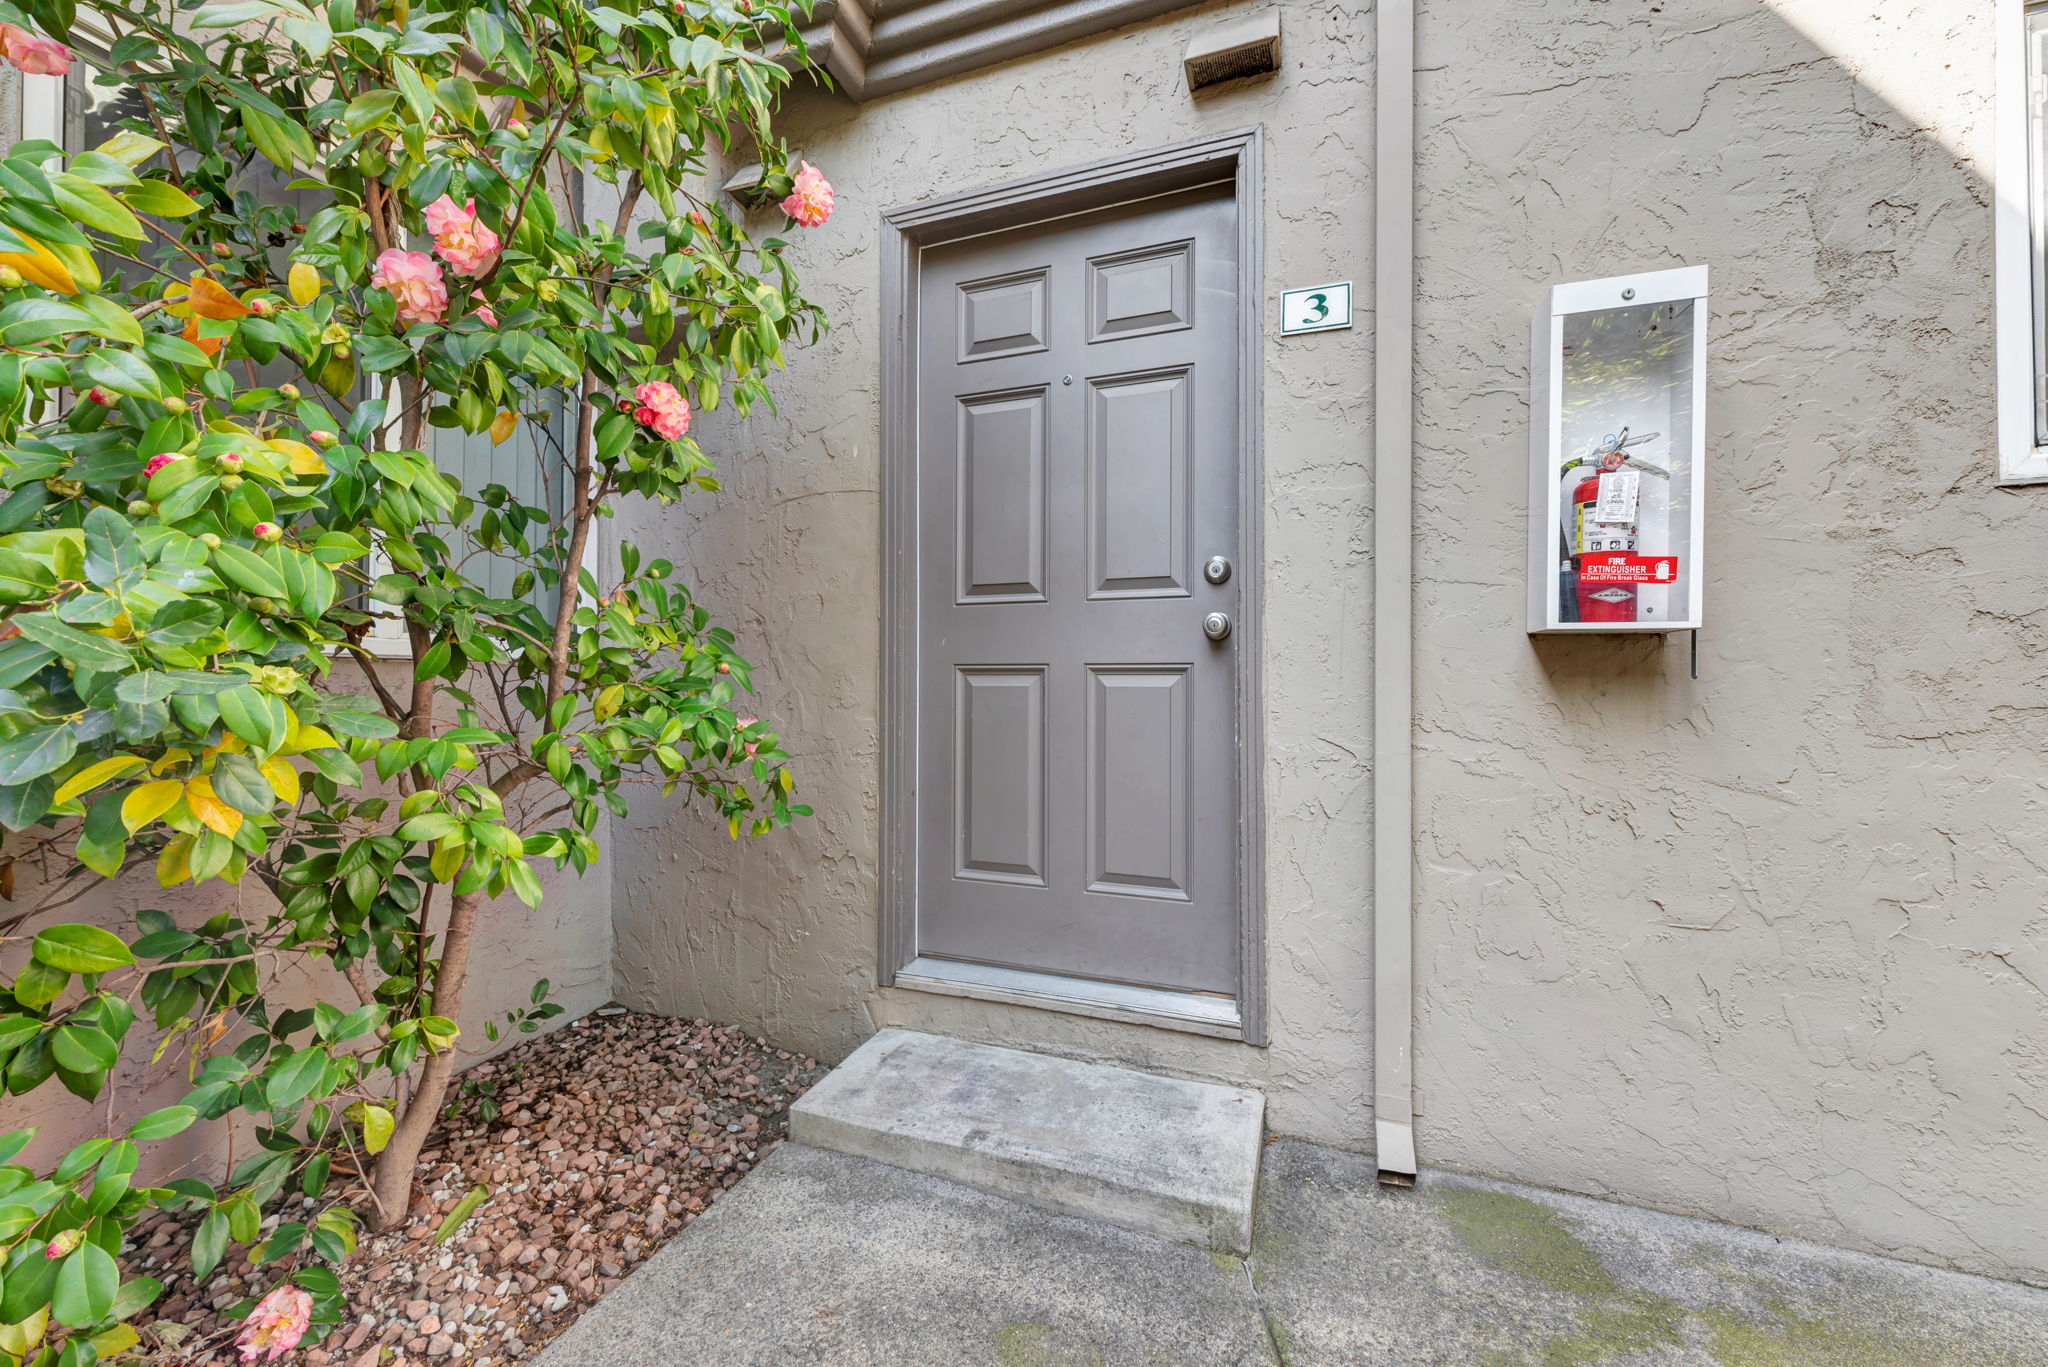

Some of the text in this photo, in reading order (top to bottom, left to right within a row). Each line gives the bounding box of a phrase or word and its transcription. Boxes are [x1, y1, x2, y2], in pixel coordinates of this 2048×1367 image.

[1302, 294, 1329, 324] 3
[1608, 557, 1626, 565] FIRE
[1587, 565, 1646, 573] EXTINGUISHER
